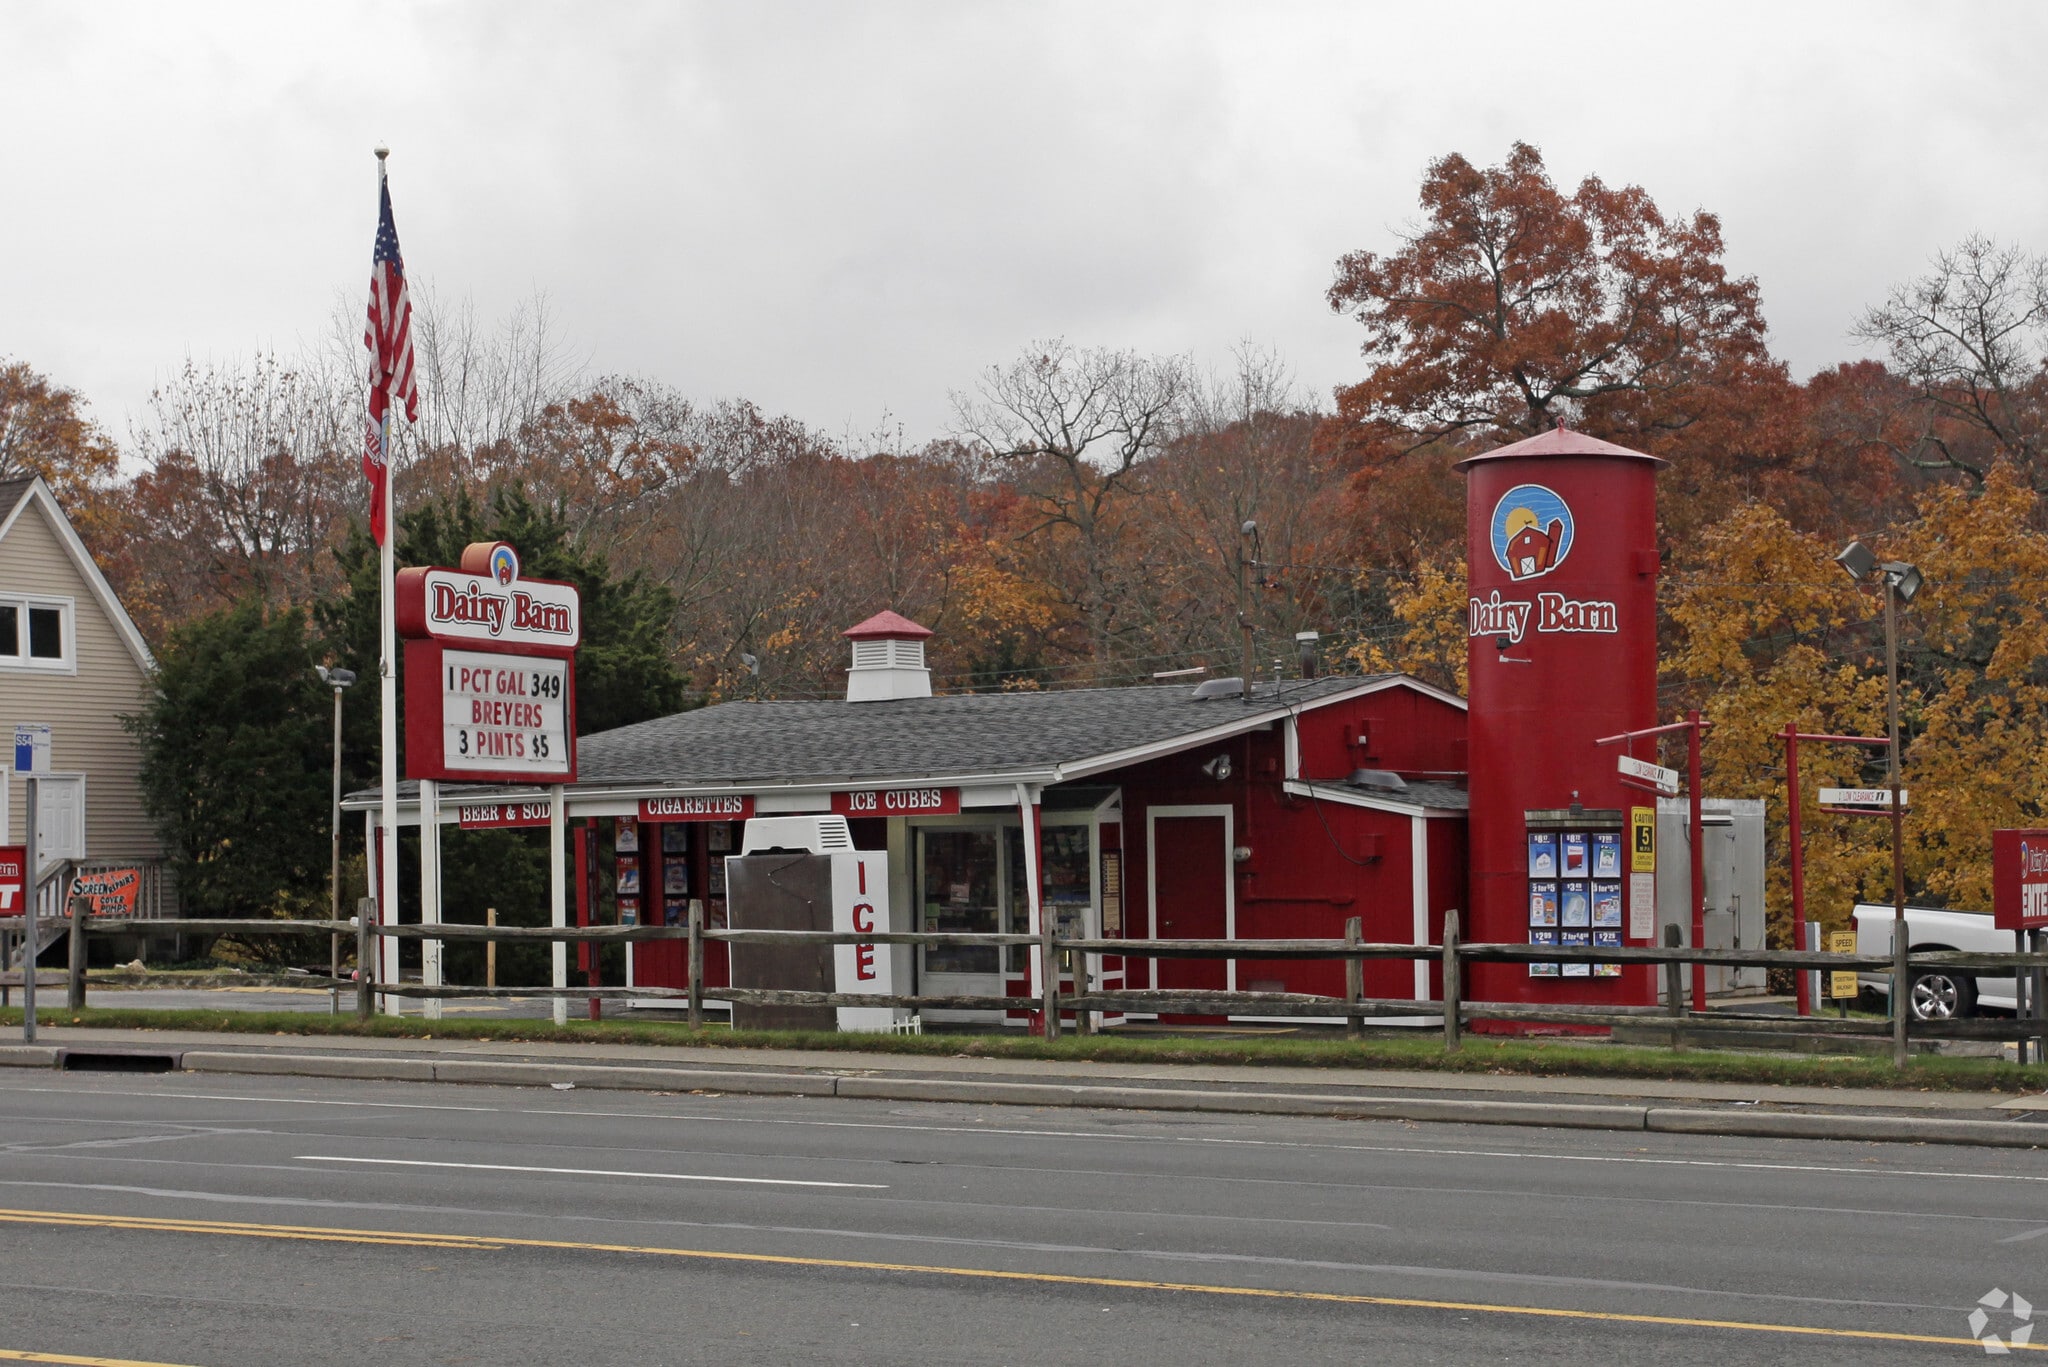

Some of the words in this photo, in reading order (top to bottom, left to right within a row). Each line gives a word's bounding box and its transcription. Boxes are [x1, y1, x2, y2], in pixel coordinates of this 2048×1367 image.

[432, 581, 508, 635] Dairy
[512, 592, 572, 634] Barn
[1470, 590, 1531, 643] Dairy
[1537, 592, 1618, 633] Barn
[461, 667, 492, 693] PCT
[496, 670, 526, 696] GAL
[531, 673, 560, 699] 349
[472, 700, 543, 728] BREYERS
[16, 735, 32, 746] S54
[460, 730, 469, 754] 3
[477, 731, 525, 757] PINTS
[532, 734, 549, 758] $5
[647, 796, 743, 815] CIGARETTES
[849, 792, 877, 810] ICE
[885, 789, 942, 809] CUBES
[462, 804, 499, 822] BEER
[505, 804, 516, 820] &
[522, 803, 551, 820] SOD
[1642, 827, 1650, 845] 5
[73, 878, 108, 896] SCREEN
[67, 896, 97, 914] PL
[100, 896, 125, 904] COVER
[101, 904, 127, 913] PUMPS
[853, 861, 876, 981] ICE
[1835, 939, 1853, 947] SPEED
